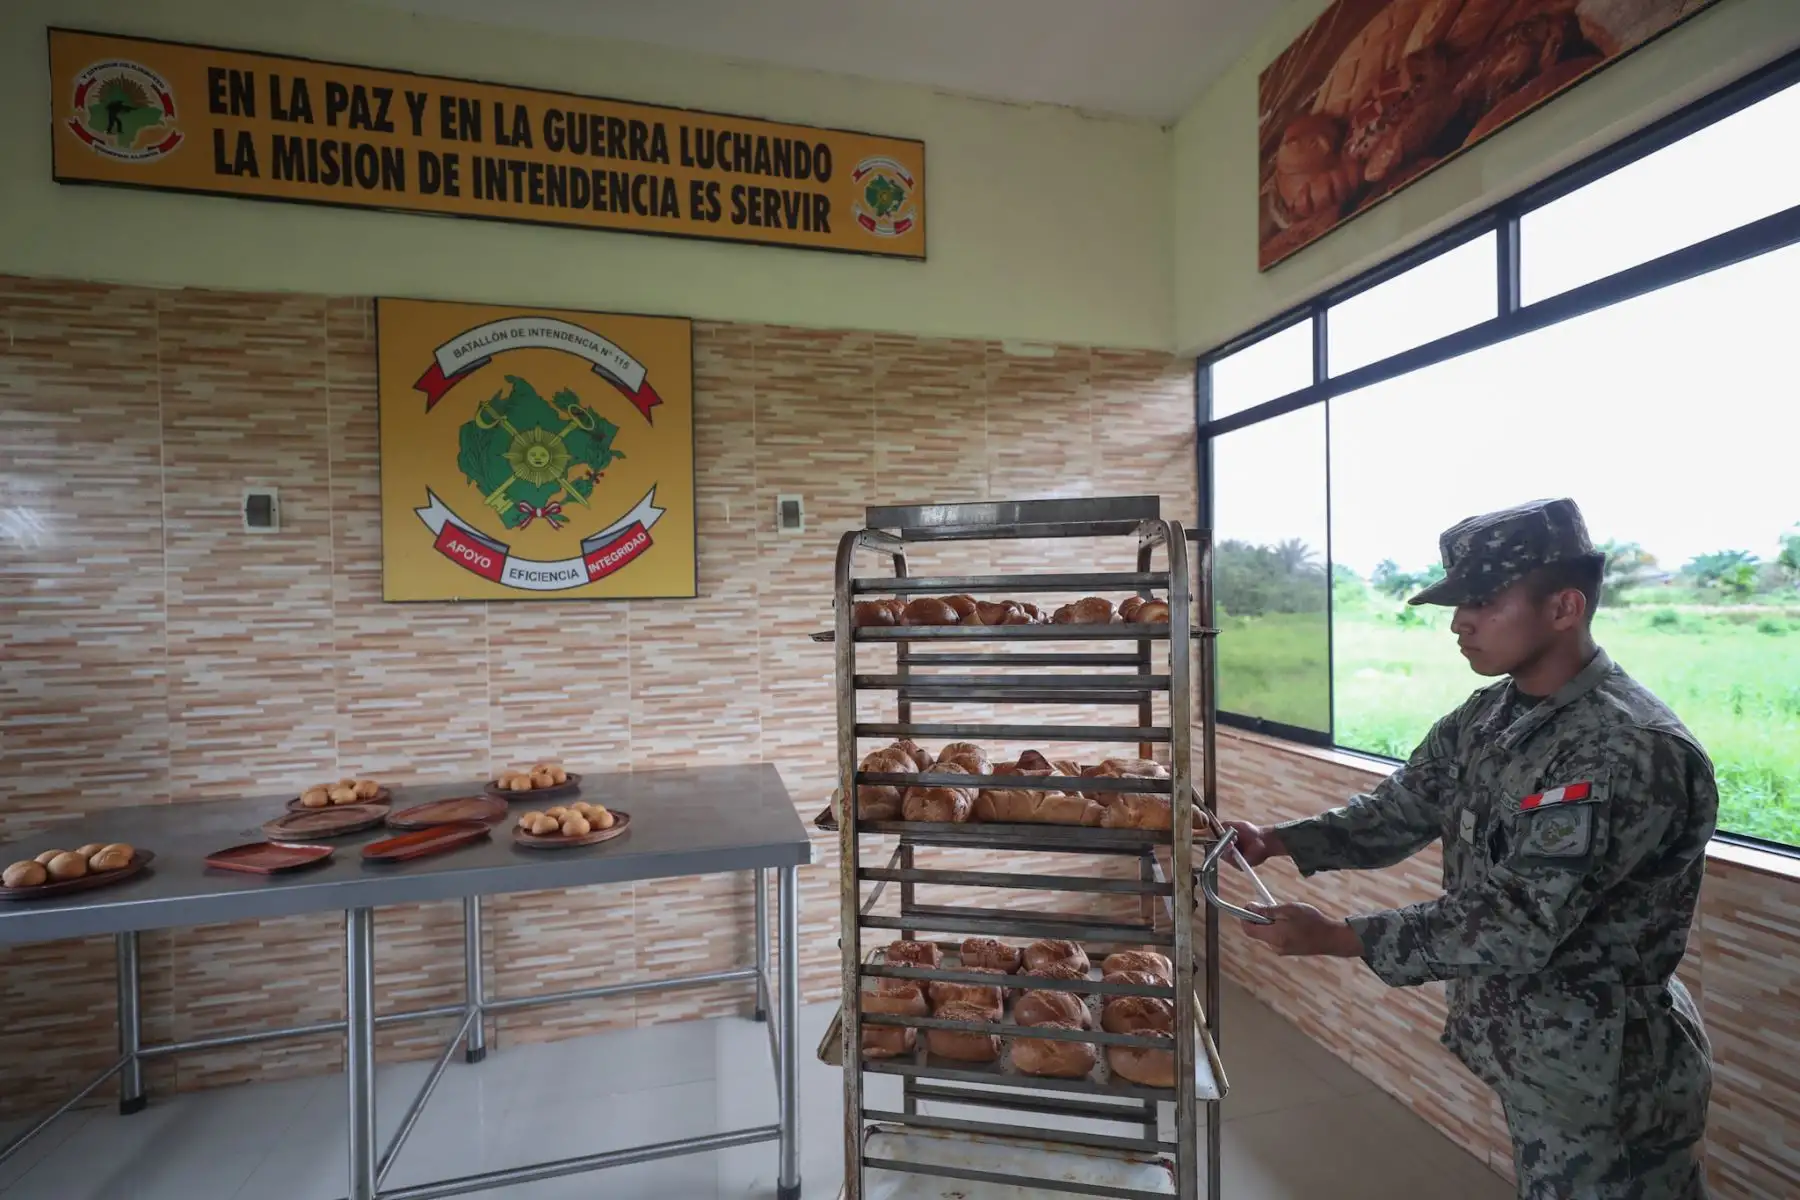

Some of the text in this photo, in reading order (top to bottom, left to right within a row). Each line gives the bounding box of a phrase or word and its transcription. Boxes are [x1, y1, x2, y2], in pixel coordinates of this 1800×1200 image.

[208, 67, 255, 118] EN
[269, 74, 314, 124] LA
[325, 80, 394, 133] PAZ
[405, 91, 428, 136] Y
[440, 95, 482, 143] EN
[494, 102, 533, 149] LA
[543, 108, 670, 165] GUERRA
[679, 125, 832, 183] LUCHANDO
[213, 128, 831, 234] LA MISION DE INTENDENCIA ES SERVIR
[453, 328, 508, 359] BATALLÓN
[511, 328, 526, 338] DE
[528, 328, 600, 353] INTENDENCIA
[446, 532, 647, 582] APOYO EFICIENCIA INTEGRIDAD
